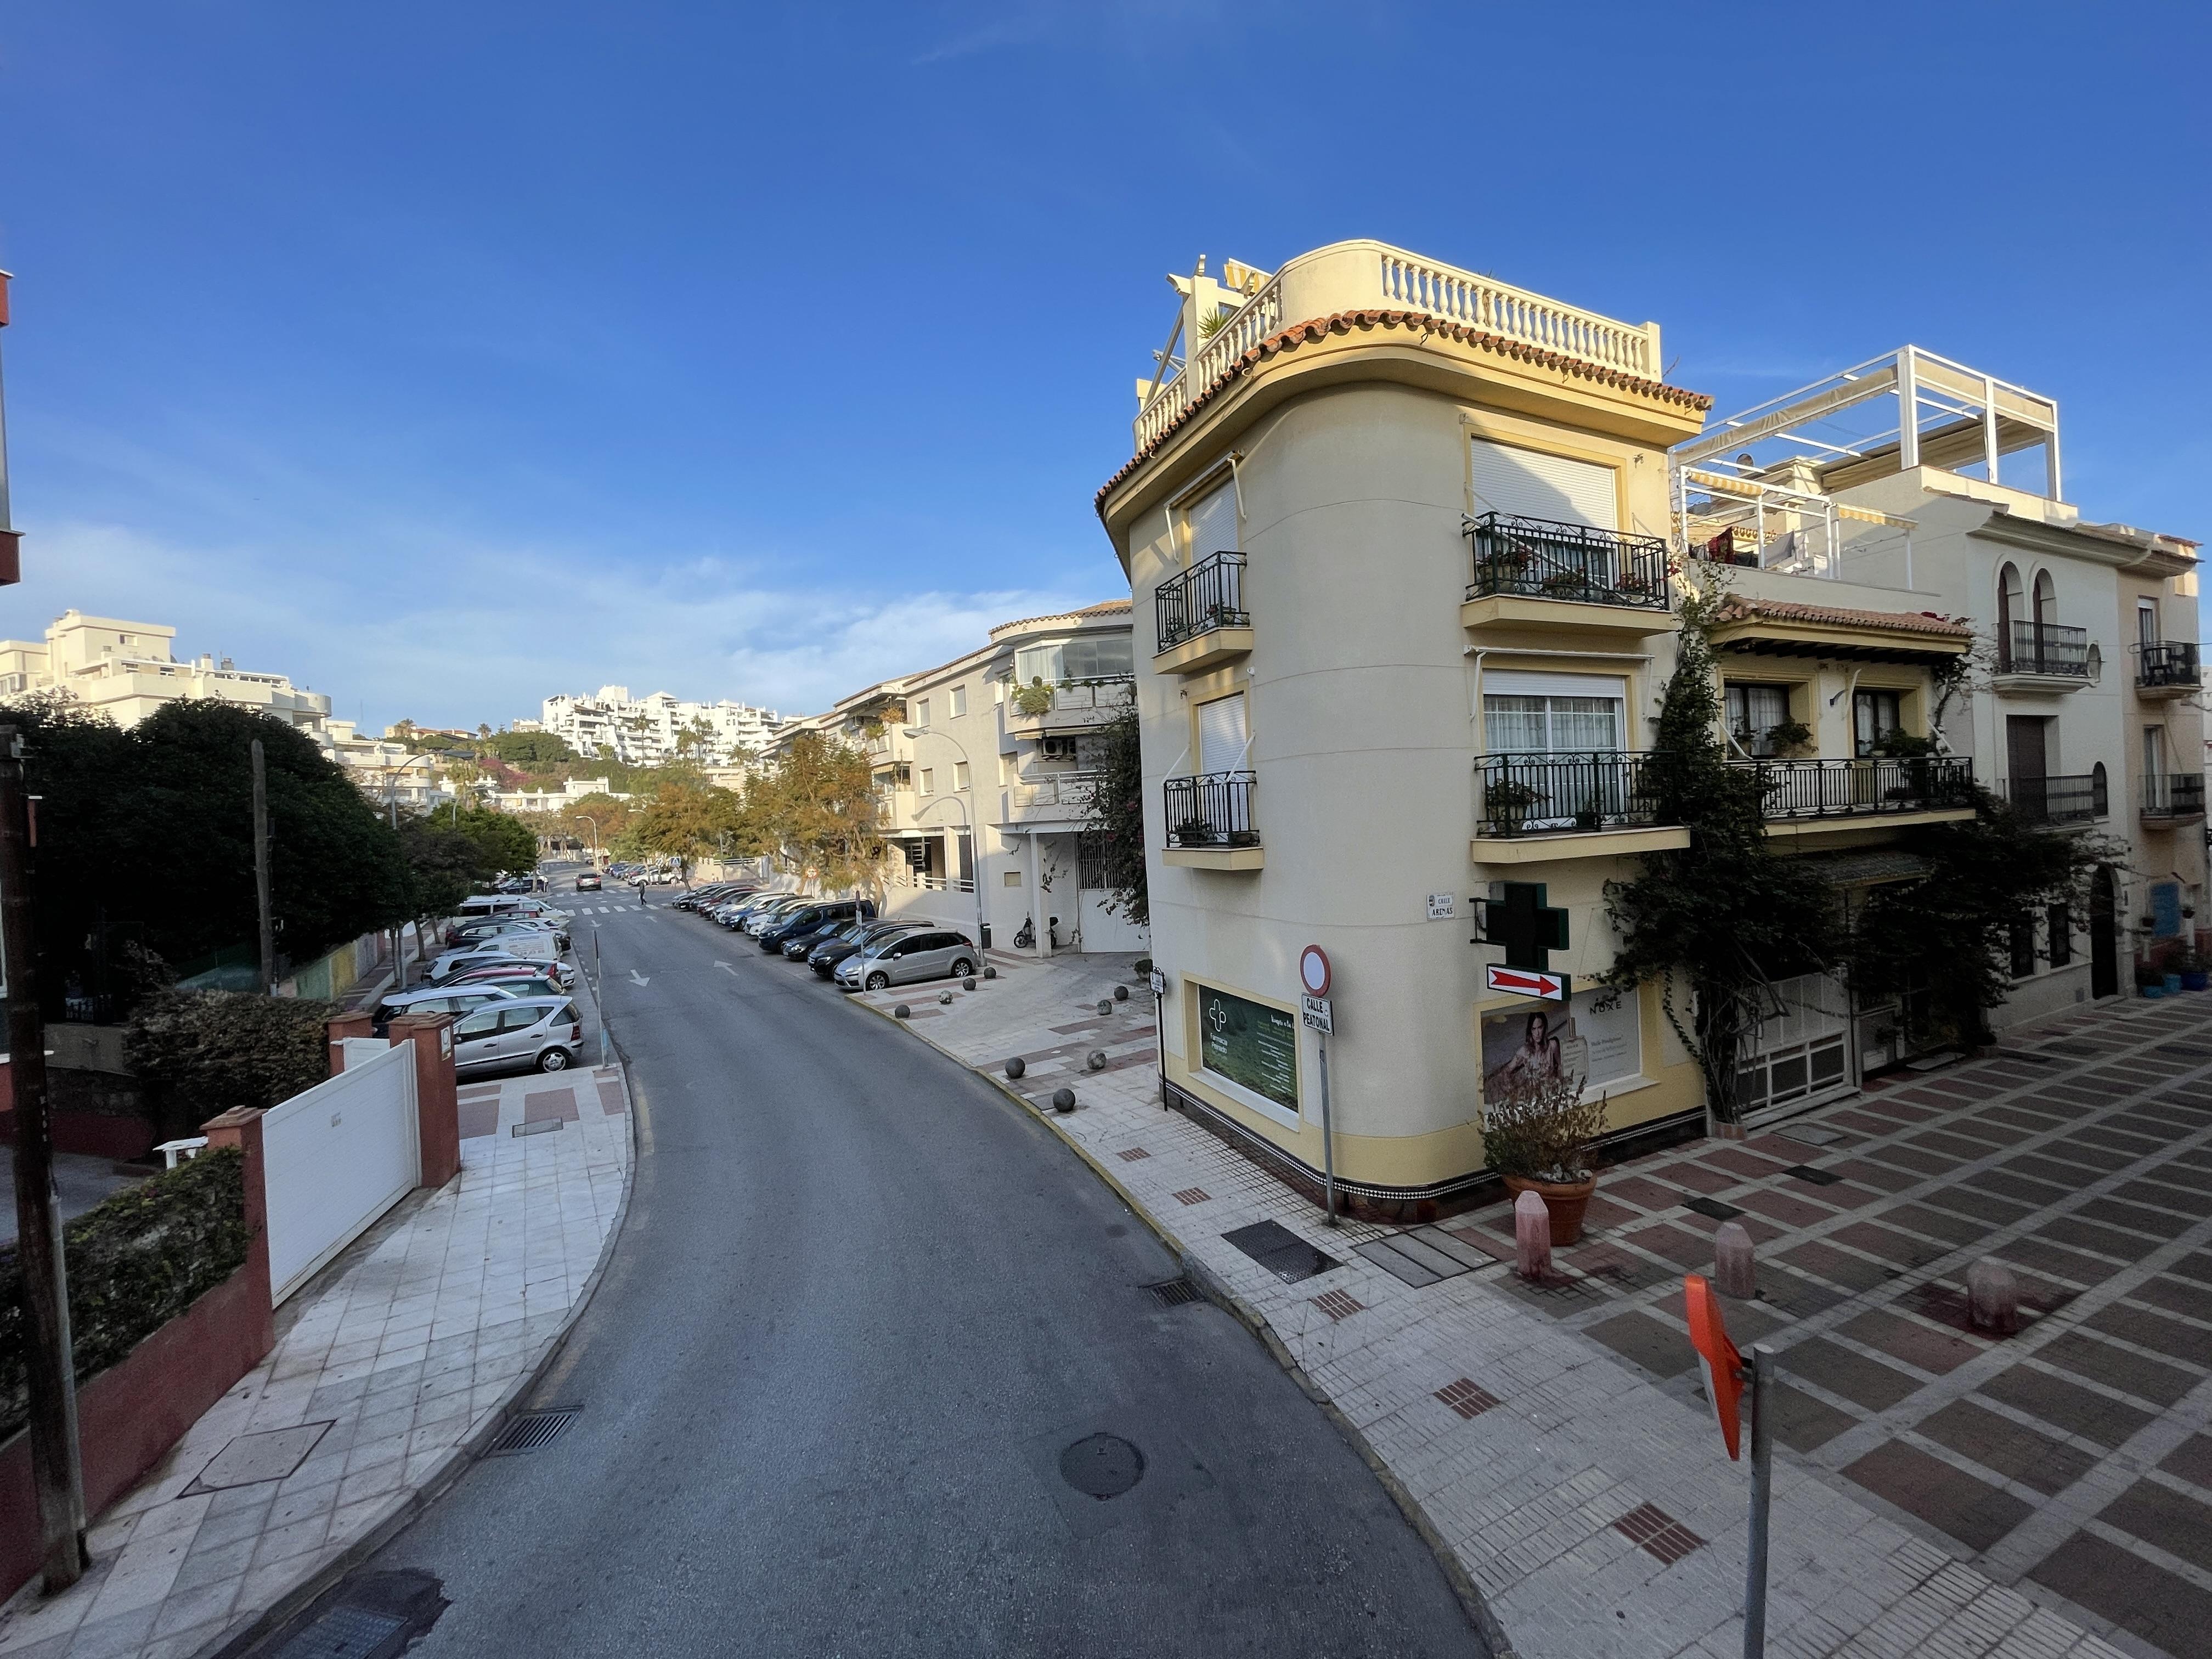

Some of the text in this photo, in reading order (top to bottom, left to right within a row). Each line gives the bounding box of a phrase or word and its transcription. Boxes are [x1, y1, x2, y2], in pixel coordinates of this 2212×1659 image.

[1432, 907, 1453, 916] ARENAS
[1307, 997, 1323, 1014] CALLE
[1590, 1001, 1622, 1015] NUXE
[1304, 1012, 1330, 1031] PEATONAL
